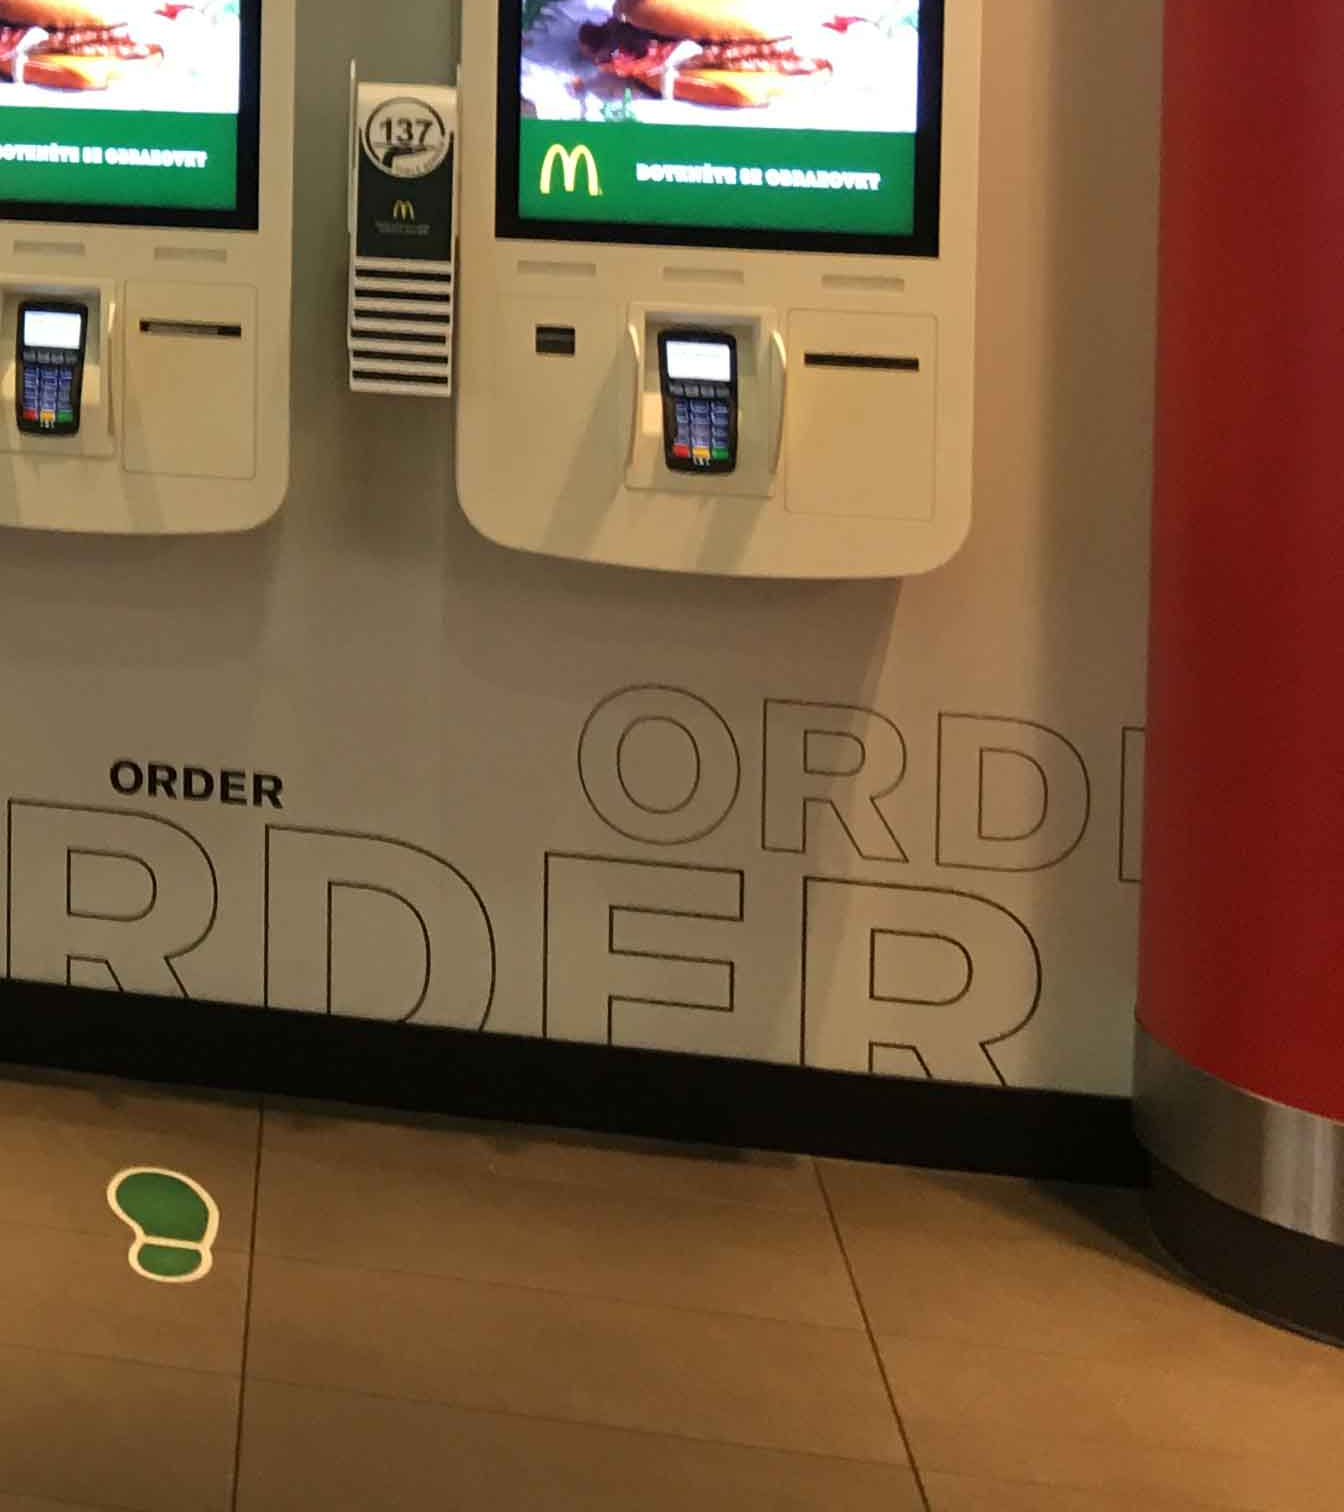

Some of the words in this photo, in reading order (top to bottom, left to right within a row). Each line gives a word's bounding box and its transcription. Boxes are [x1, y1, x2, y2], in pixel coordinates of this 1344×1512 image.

[379, 118, 433, 144] 137
[111, 760, 284, 808] ORDER
[577, 683, 1145, 883] ORD
